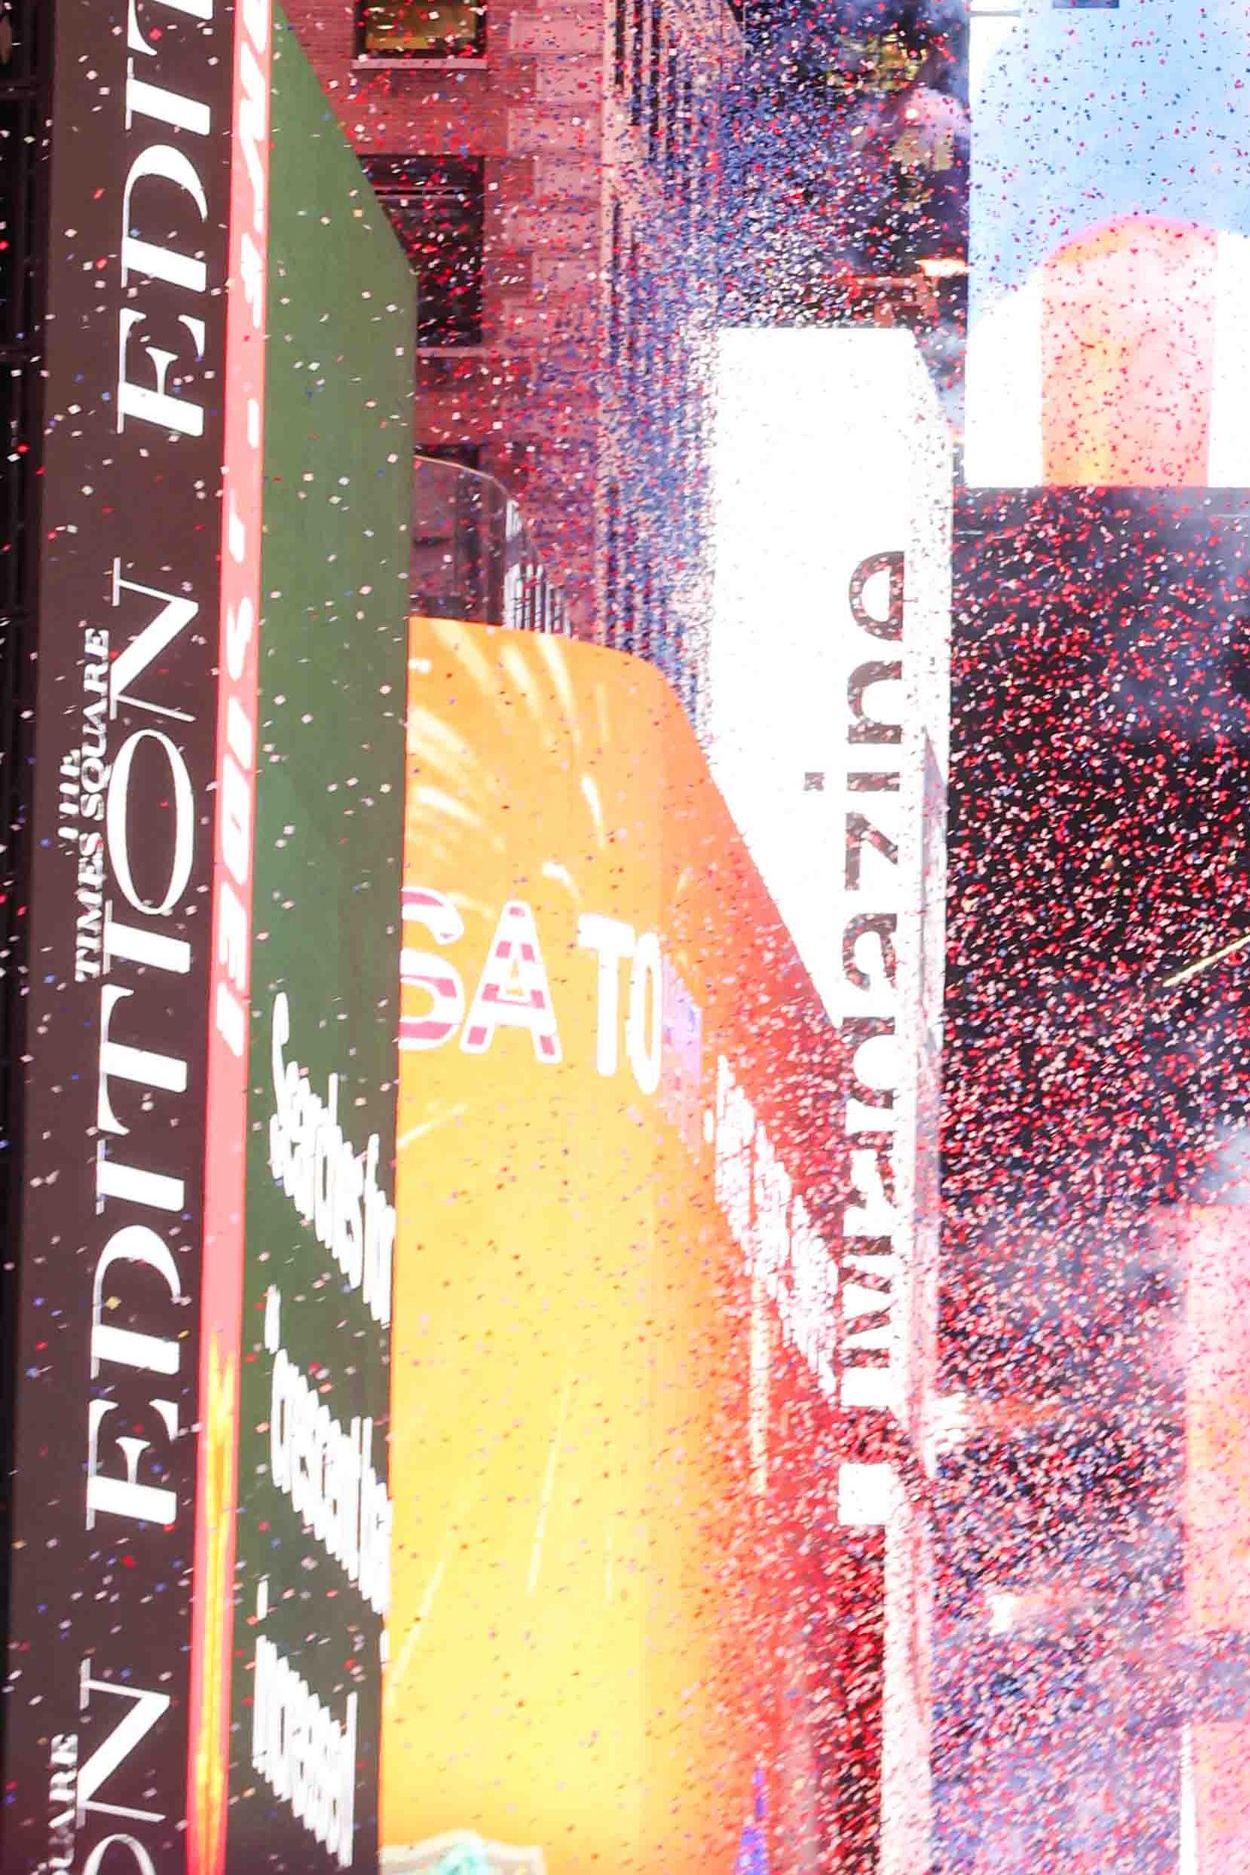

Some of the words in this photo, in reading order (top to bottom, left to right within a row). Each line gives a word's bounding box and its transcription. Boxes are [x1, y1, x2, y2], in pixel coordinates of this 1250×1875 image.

[57, 749, 80, 839] THE
[81, 627, 111, 821] SQUARE
[75, 831, 104, 980] TIMES
[87, 556, 199, 1529] EDITION
[48, 1732, 79, 1874] UARE
